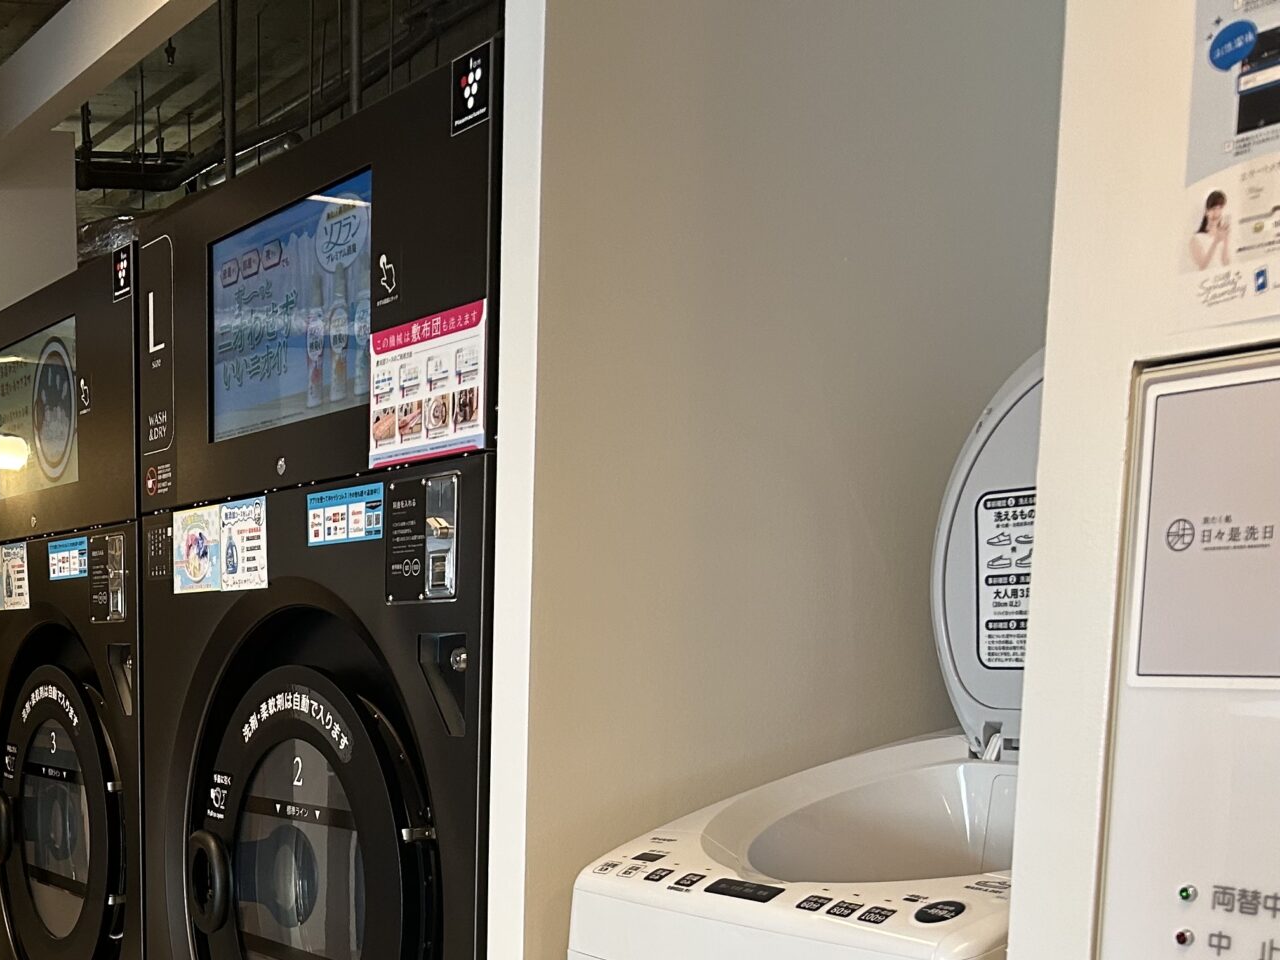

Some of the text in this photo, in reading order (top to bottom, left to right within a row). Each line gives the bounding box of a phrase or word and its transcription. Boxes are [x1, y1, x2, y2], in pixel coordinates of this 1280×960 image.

[148, 291, 166, 354] L
[375, 309, 479, 352] この機械は敷布団も洗えます
[148, 410, 168, 426] WASH
[993, 508, 1035, 523] 洗えるもの
[241, 691, 350, 744] 洗剤・柔軟剤は自動で入ります
[50, 731, 57, 754] 3
[292, 756, 304, 787] 2
[1211, 884, 1280, 919] 両替中
